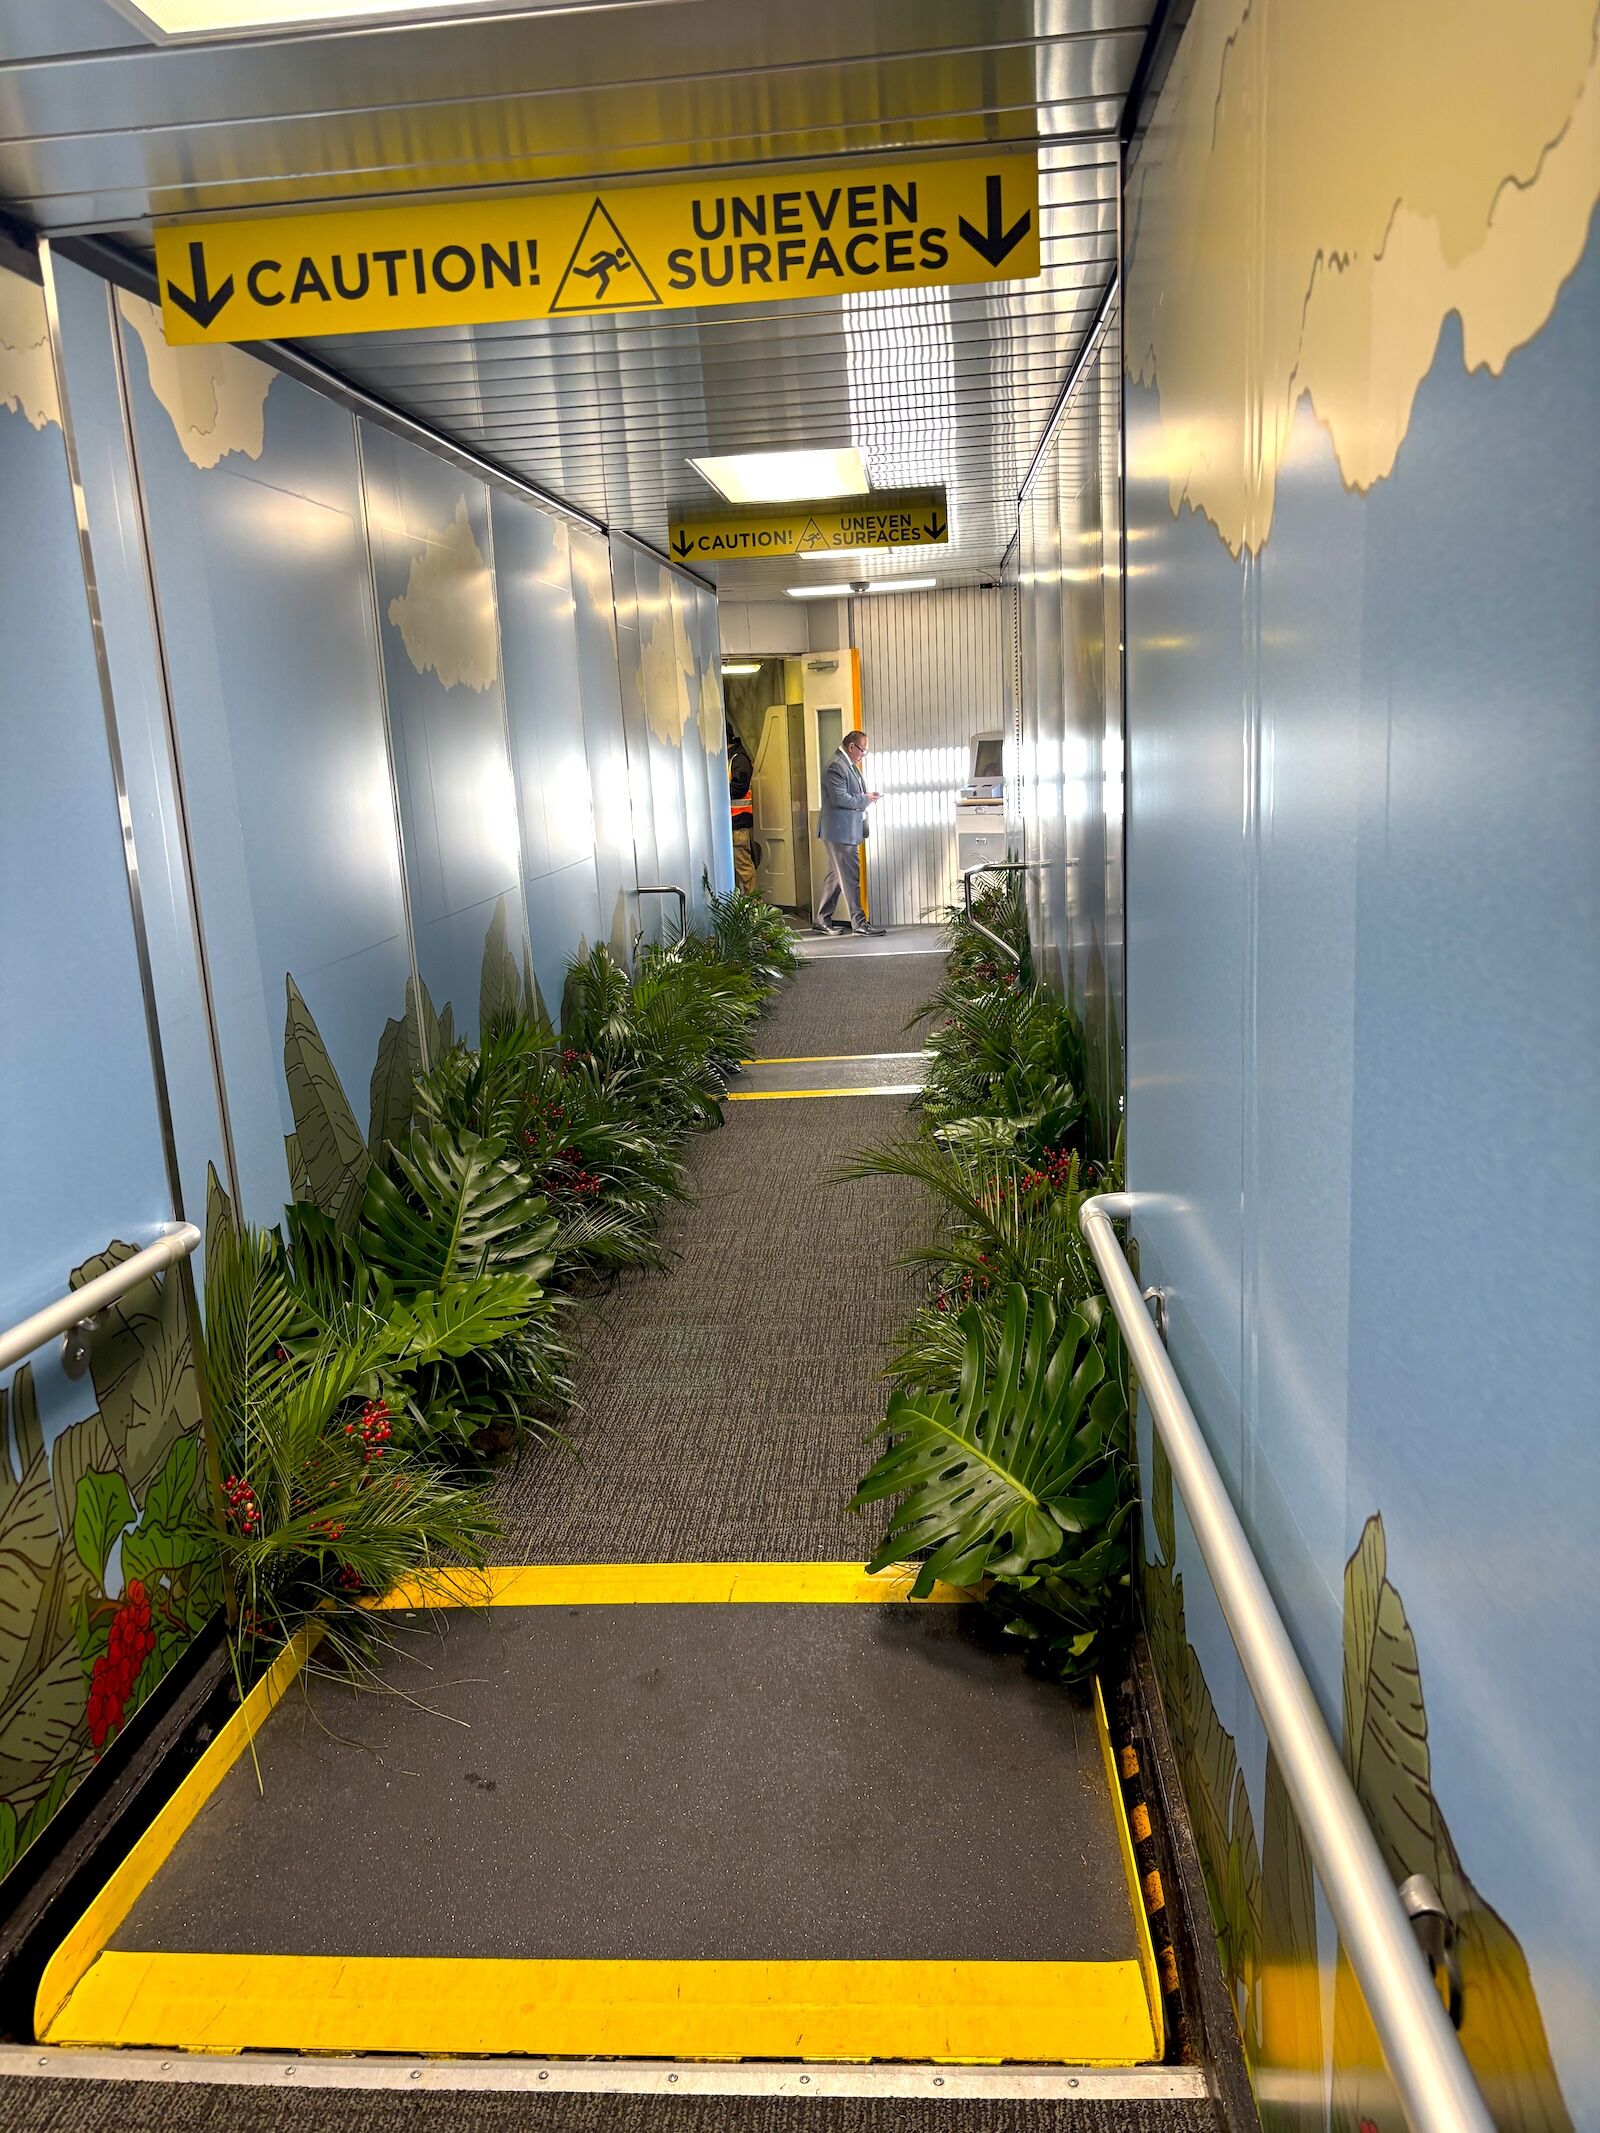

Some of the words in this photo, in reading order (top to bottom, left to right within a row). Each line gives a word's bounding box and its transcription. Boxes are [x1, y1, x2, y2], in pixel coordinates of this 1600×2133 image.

[691, 181, 919, 241] UNEVEN
[246, 240, 540, 307] CAUTION!
[667, 228, 949, 290] SURFACES
[697, 529, 793, 551] CAUTION!
[832, 527, 921, 546] SURFACES
[840, 514, 911, 531] UNEVEN
